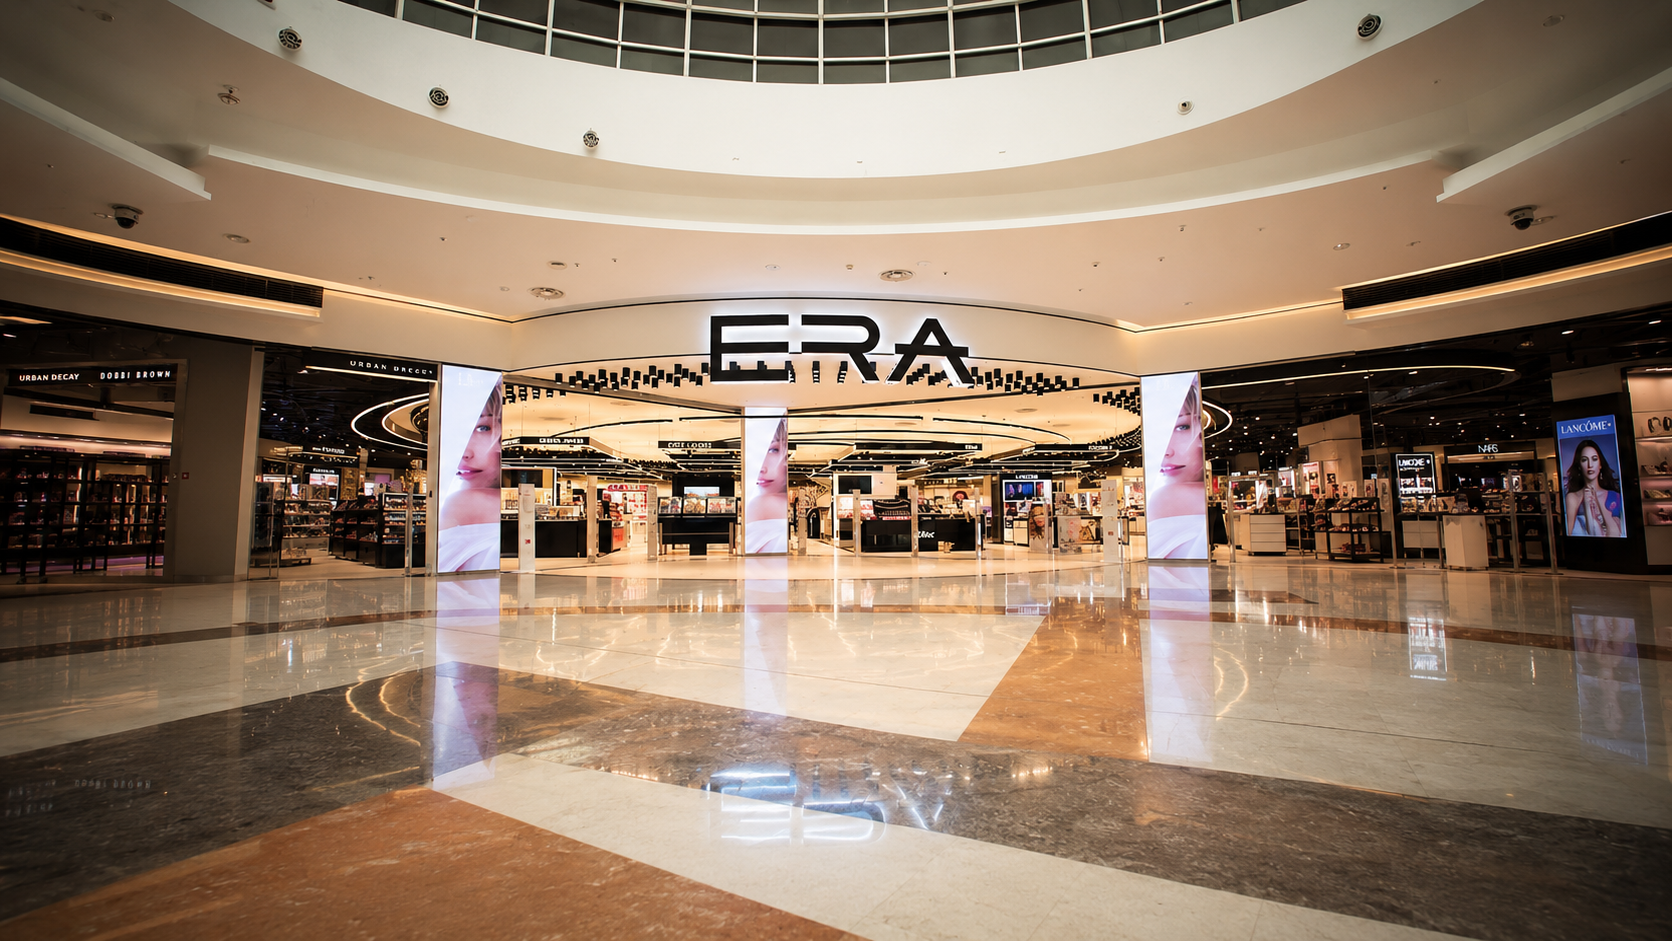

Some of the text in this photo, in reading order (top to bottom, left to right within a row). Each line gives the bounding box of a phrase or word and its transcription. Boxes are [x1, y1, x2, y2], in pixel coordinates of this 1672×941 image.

[711, 314, 976, 383] ERA
[19, 373, 80, 382] URBAN DECAY
[135, 371, 171, 379] BROWN
